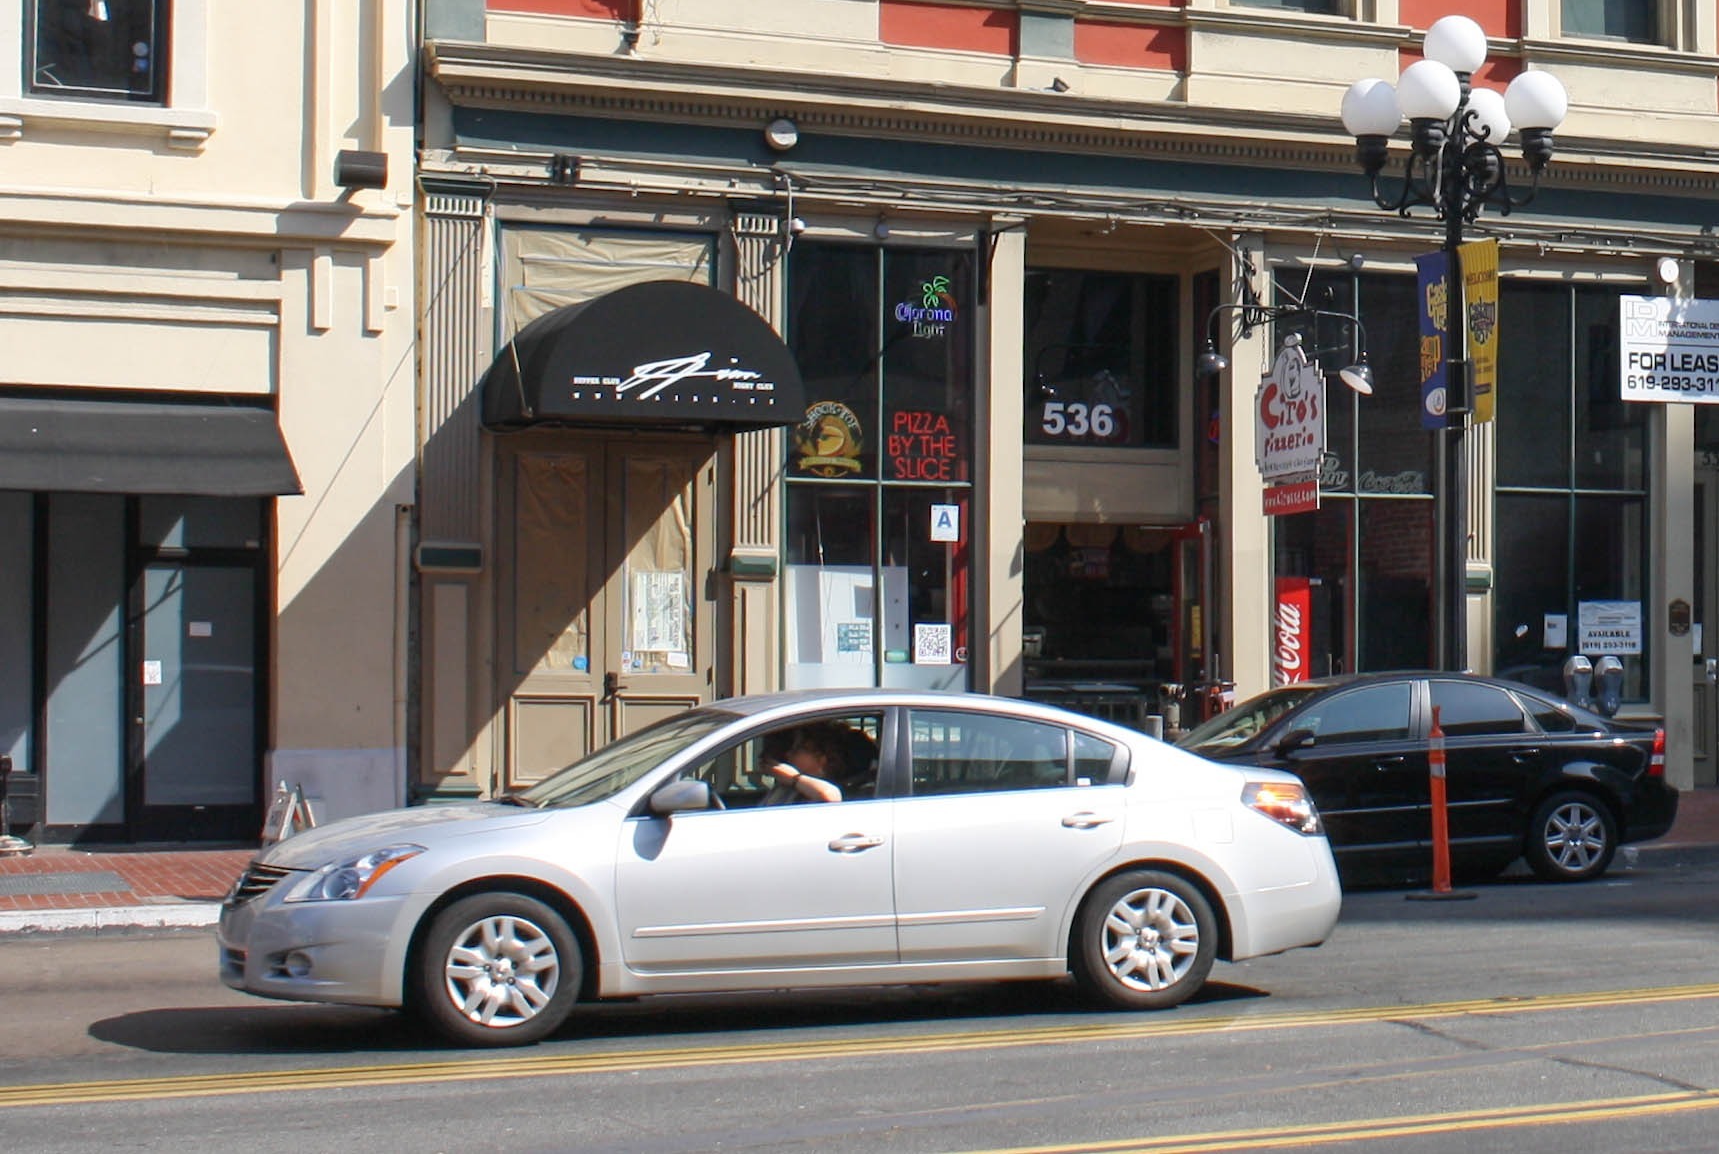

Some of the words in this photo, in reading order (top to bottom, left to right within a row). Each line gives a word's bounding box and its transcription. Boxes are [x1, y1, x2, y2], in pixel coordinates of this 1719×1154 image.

[895, 303, 952, 322] Corona
[912, 320, 945, 338] Light
[1628, 352, 1666, 372] FOR
[602, 377, 621, 385] CLUB
[732, 382, 754, 390] NIGHT
[756, 383, 774, 391] CLUB
[1260, 382, 1318, 430] Ciro's
[893, 411, 950, 435] PIZZA
[1042, 402, 1114, 437] 536
[888, 435, 915, 457] BY
[919, 435, 957, 457] THE
[1264, 426, 1314, 457] pizzeria
[894, 457, 951, 481] SLICE
[936, 511, 952, 528] A
[1588, 629, 1631, 638] AVAILABLE
